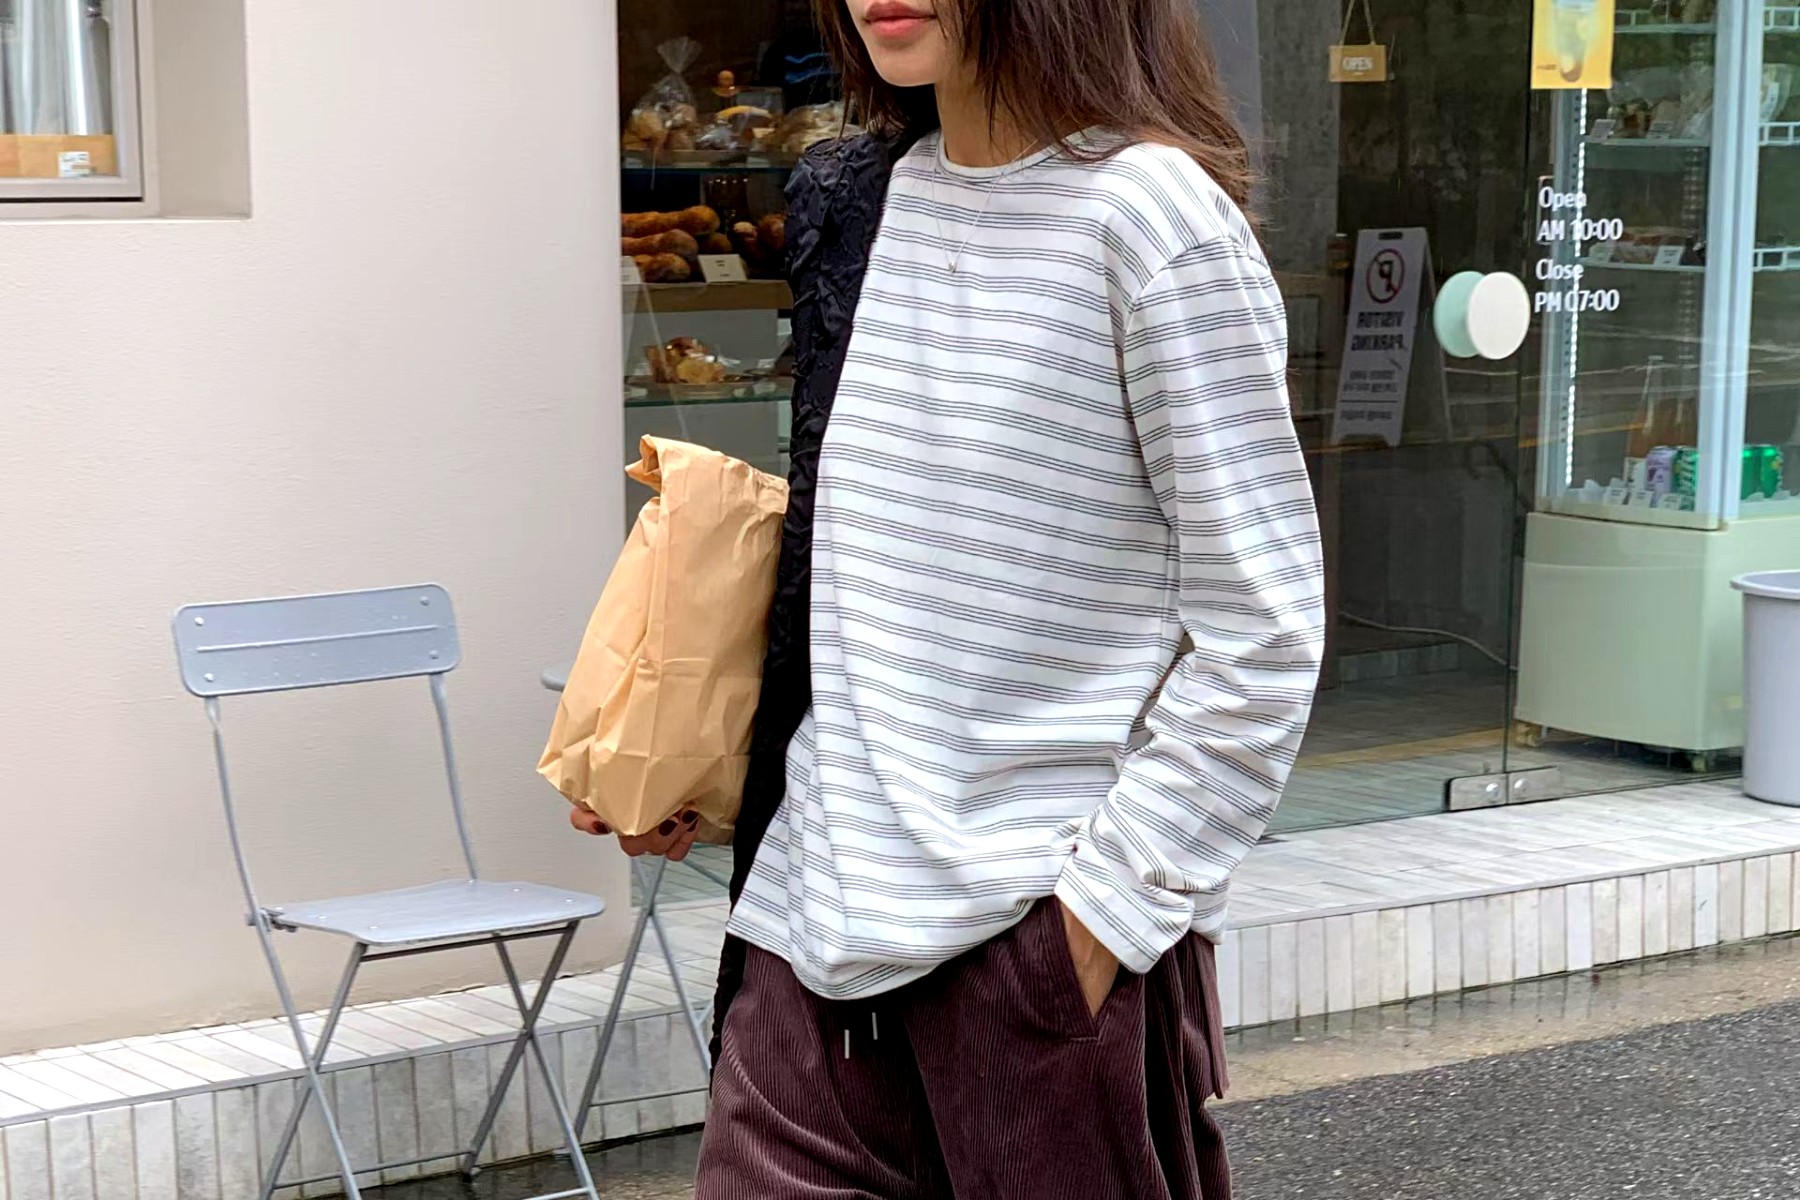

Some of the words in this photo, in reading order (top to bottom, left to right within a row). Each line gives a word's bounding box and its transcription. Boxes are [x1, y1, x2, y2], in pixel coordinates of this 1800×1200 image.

[1342, 56, 1374, 71] OPEN
[1539, 186, 1587, 212] Open
[1537, 219, 1565, 241] AM
[1569, 218, 1624, 241] 10:00
[1535, 258, 1585, 280] Close
[1534, 291, 1562, 313] PM
[1564, 289, 1620, 312] 07:00
